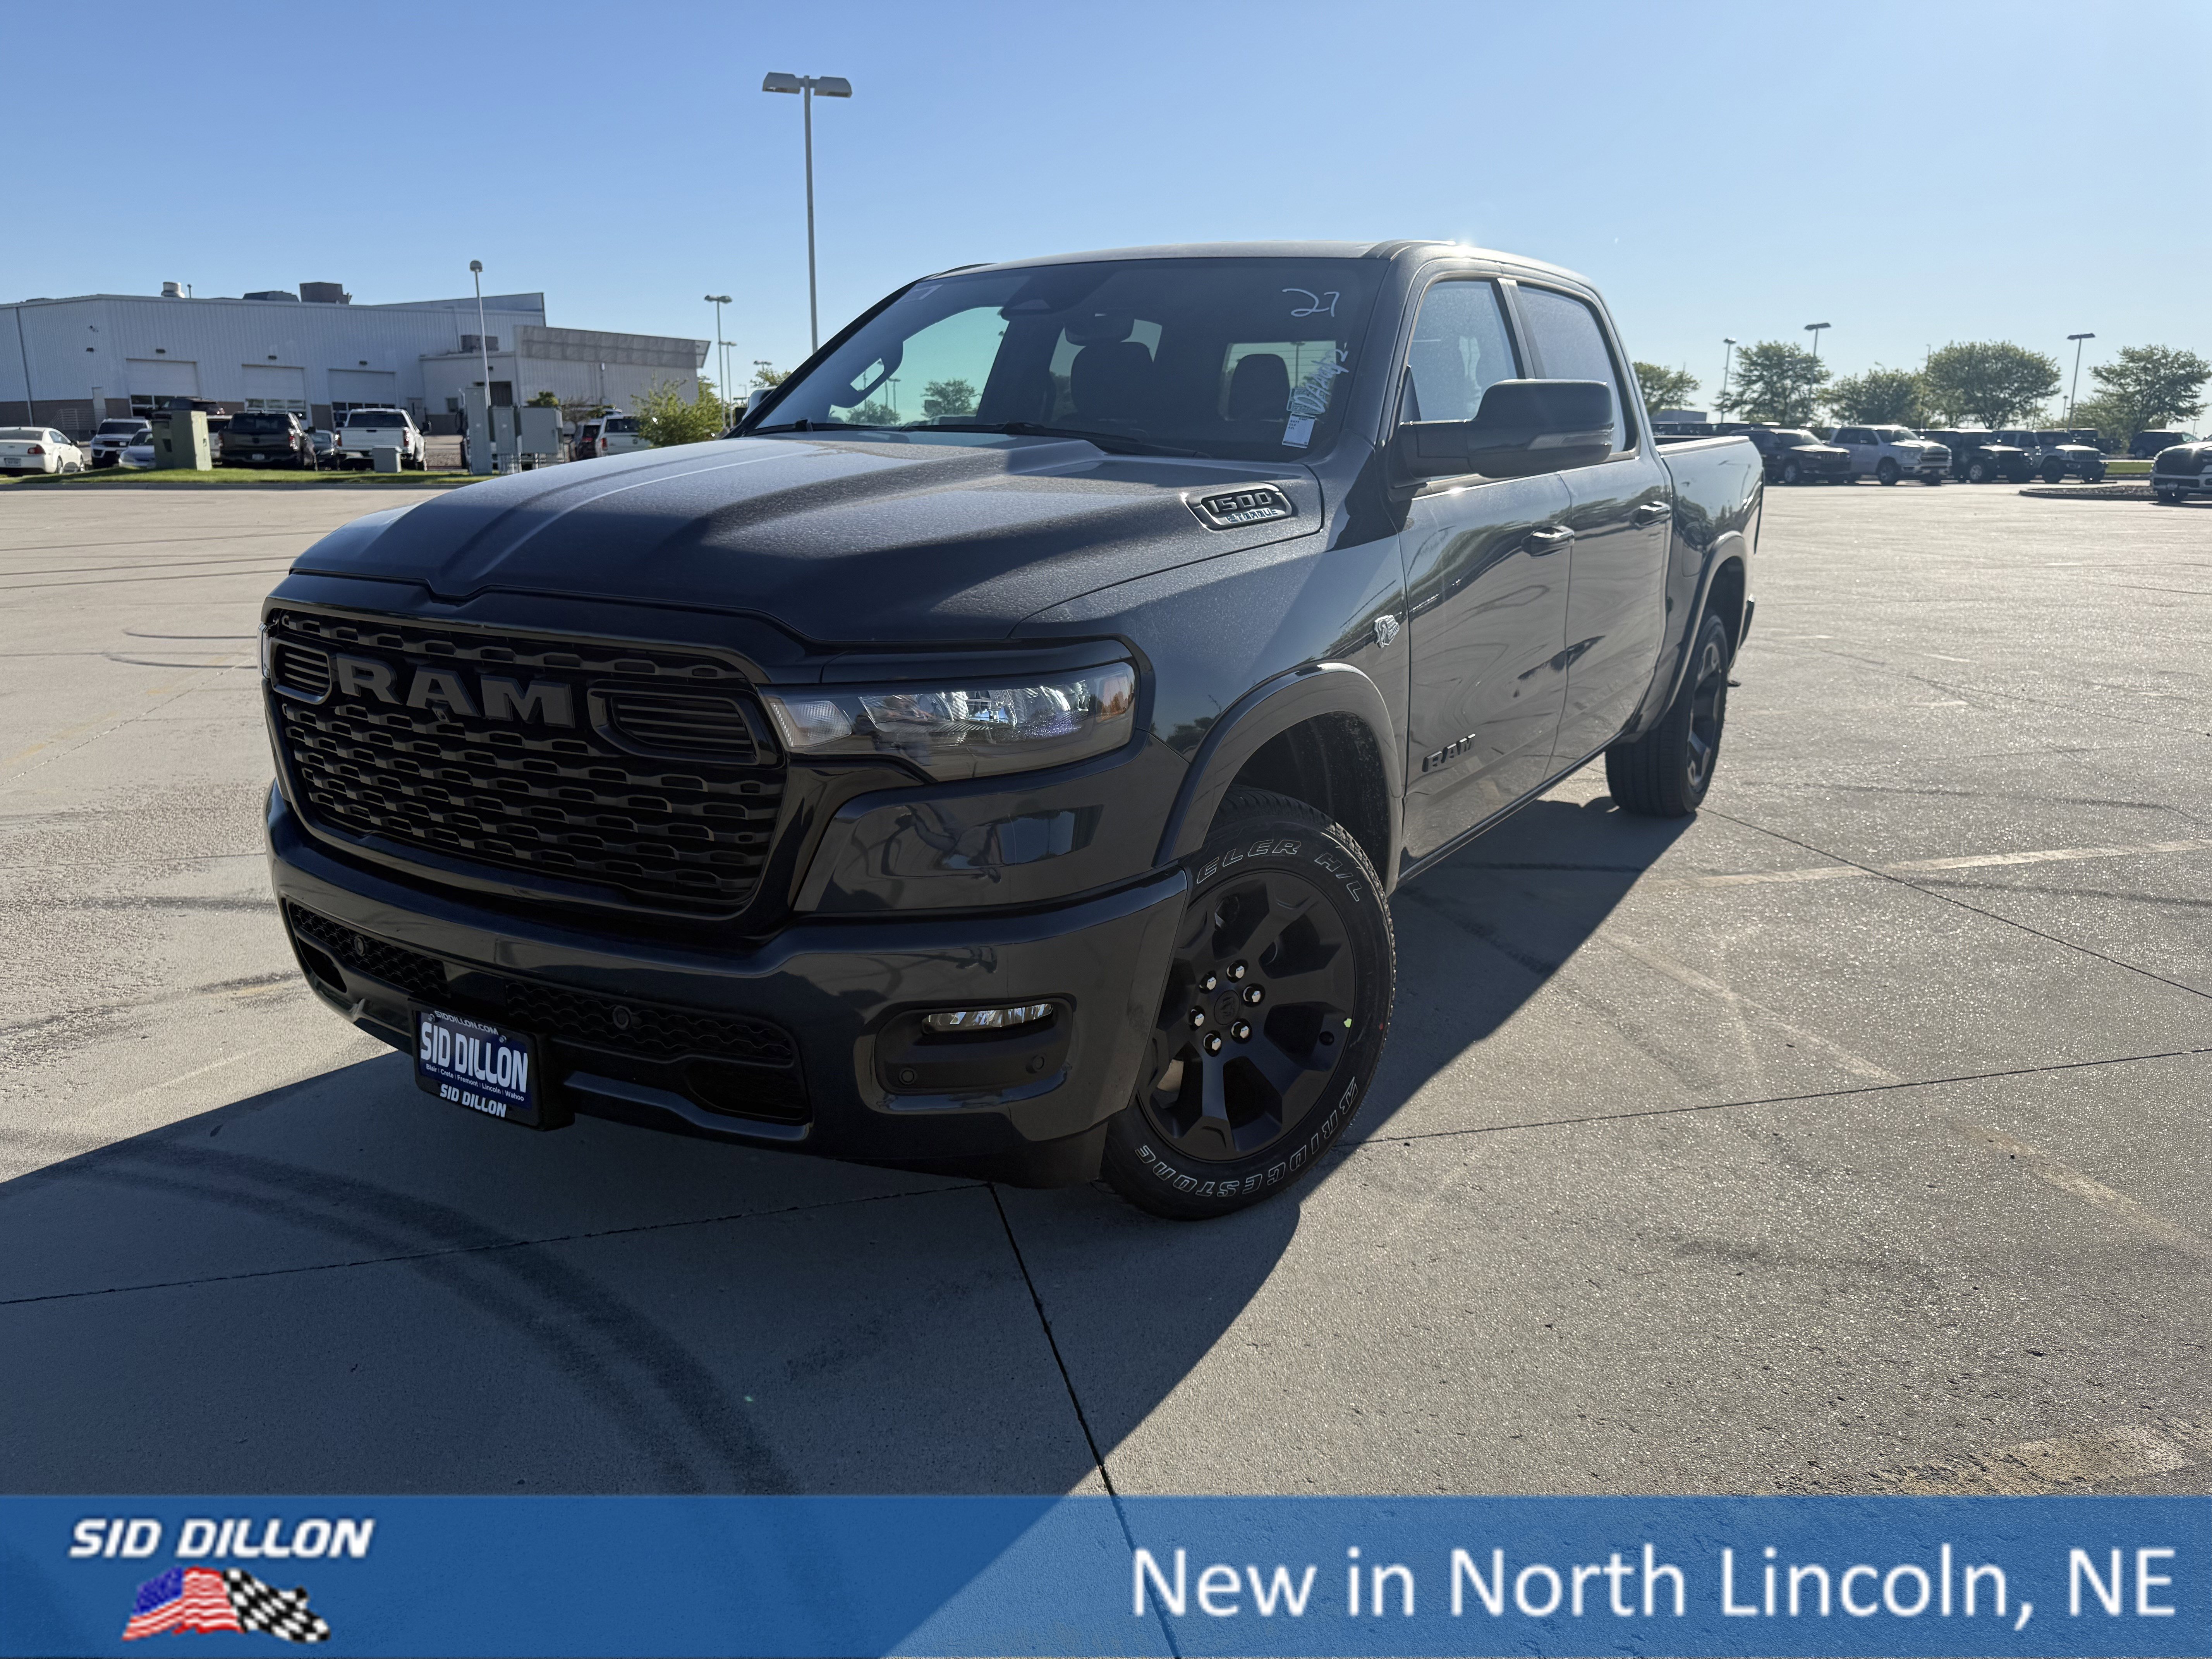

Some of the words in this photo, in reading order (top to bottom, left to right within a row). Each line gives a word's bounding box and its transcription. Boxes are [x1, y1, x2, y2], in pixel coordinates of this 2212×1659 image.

[1282, 288, 1340, 317] 27
[1208, 492, 1272, 513] 1500
[336, 653, 575, 728] RAM
[1422, 733, 1476, 772] RAM
[1197, 839, 1301, 884] ELER
[434, 1010, 499, 1035] SIDDILLON.COM
[421, 1022, 450, 1068] SID
[455, 1033, 528, 1093] DILLON
[426, 1063, 437, 1072] Blair
[440, 1068, 454, 1079] Crete
[457, 1074, 479, 1087] Fremont
[482, 1082, 501, 1094] Lincoln
[504, 1090, 524, 1102] Wahoo
[440, 1084, 460, 1102] SID
[462, 1091, 507, 1118] DILLON
[1135, 1076, 1358, 1197] BRIDGESTONE
